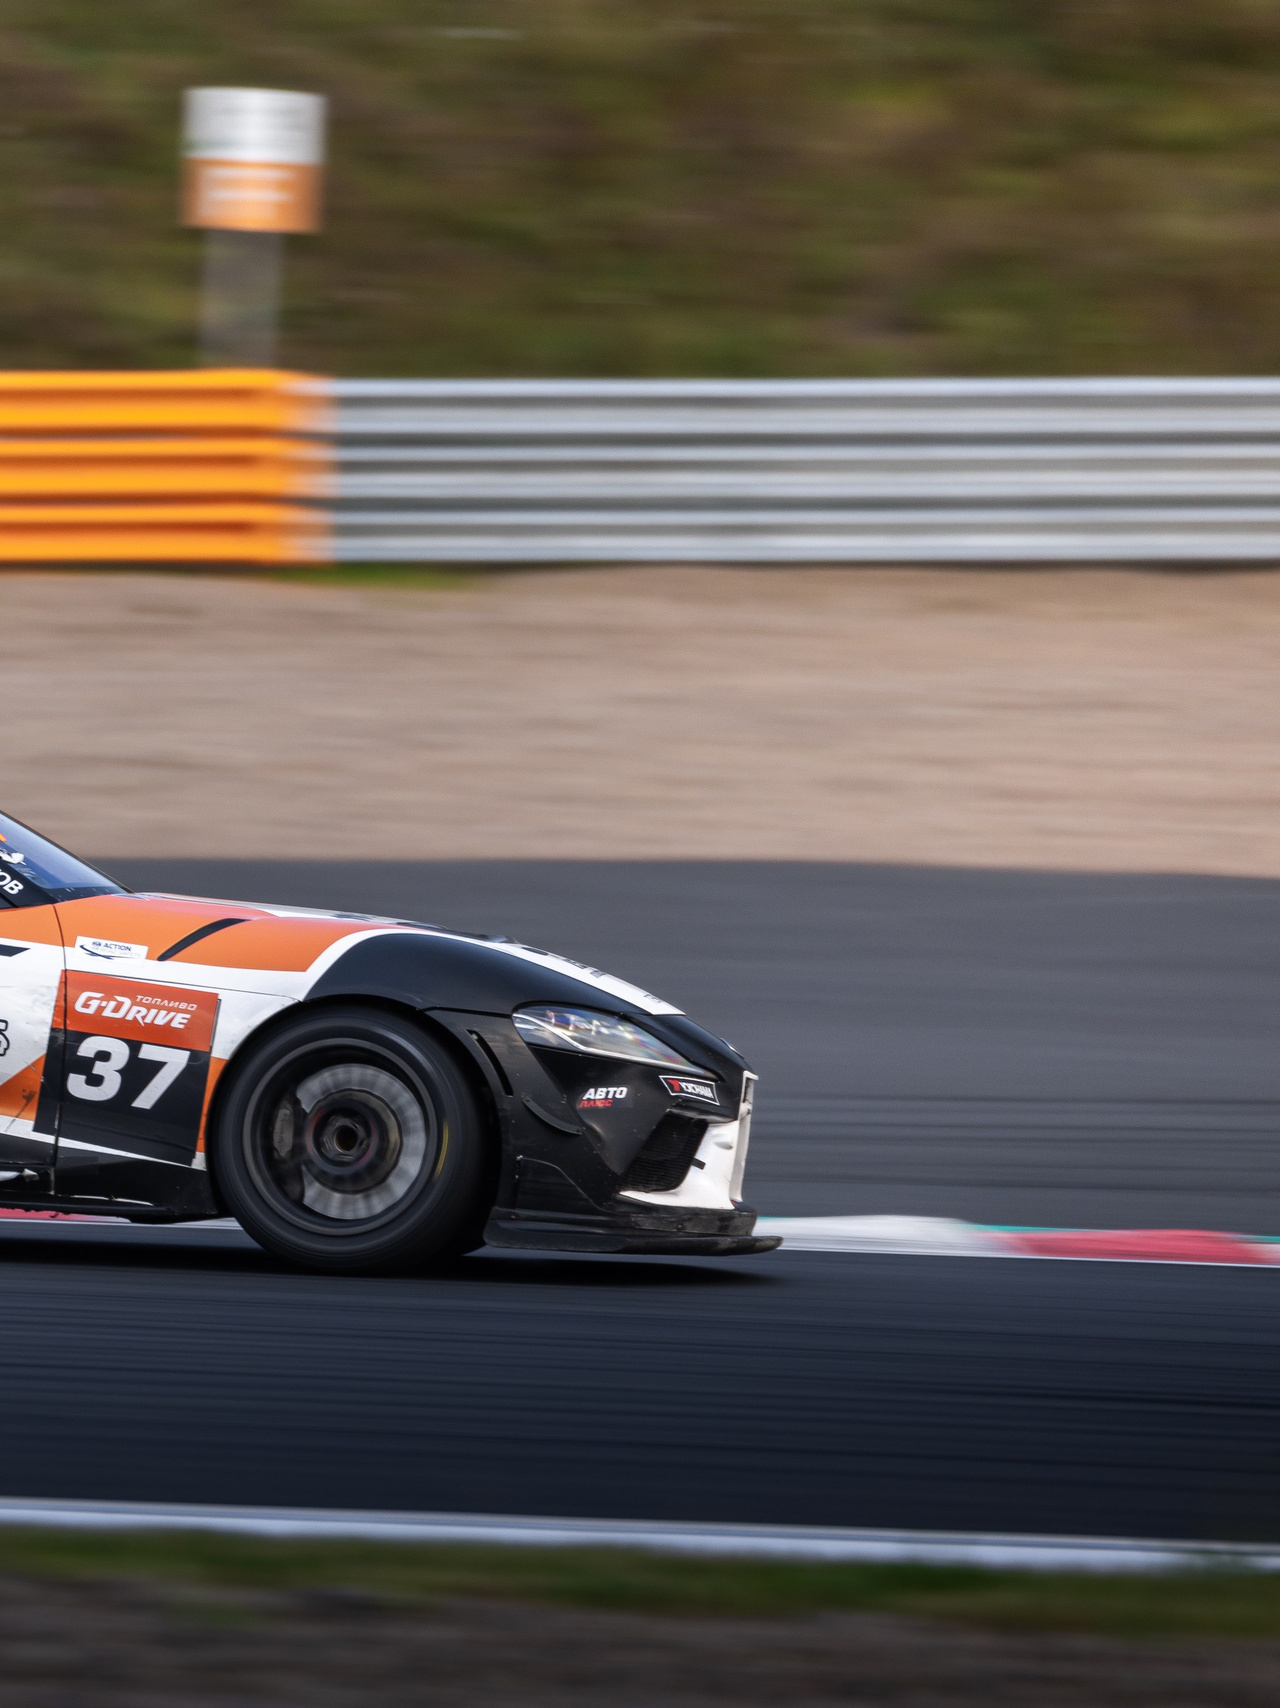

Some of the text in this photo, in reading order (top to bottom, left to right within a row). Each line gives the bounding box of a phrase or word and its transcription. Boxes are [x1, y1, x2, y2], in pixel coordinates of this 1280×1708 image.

[135, 994, 198, 1012] ТОПЛИВО
[66, 1035, 191, 1110] 37
[582, 1087, 628, 1100] АВТО
